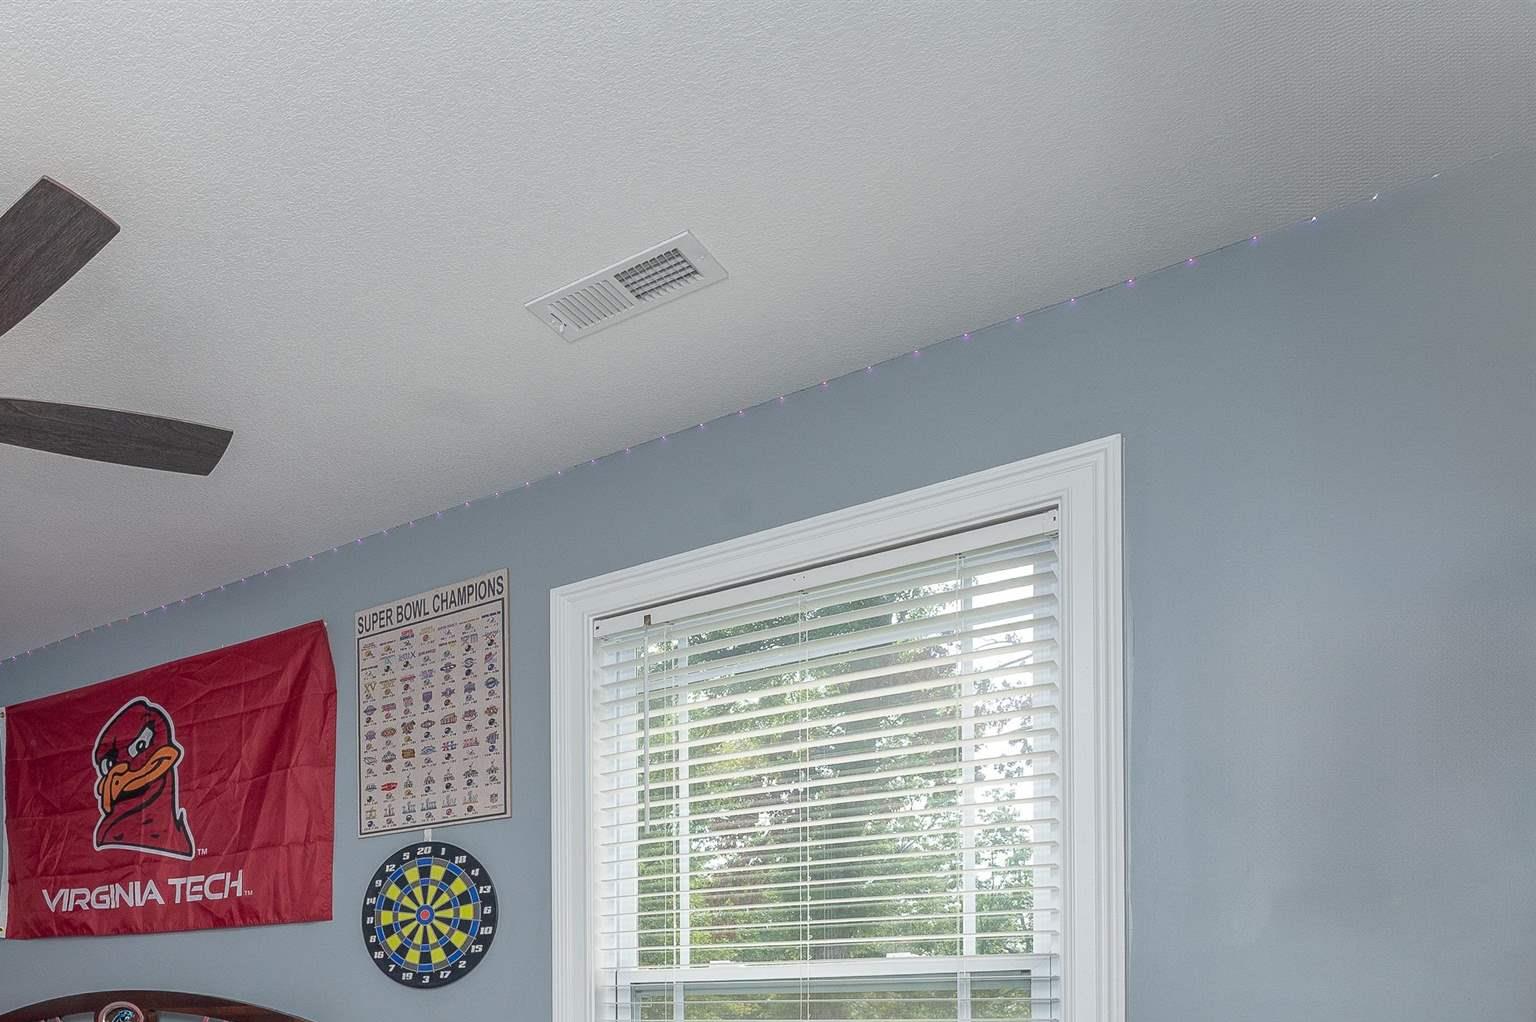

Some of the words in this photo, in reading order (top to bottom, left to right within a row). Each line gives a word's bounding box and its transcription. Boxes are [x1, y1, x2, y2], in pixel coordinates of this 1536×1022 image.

[357, 610, 395, 635] SUPER
[396, 598, 430, 623] BOWL
[431, 574, 505, 613] CHAMPIONS
[402, 851, 411, 860] 5
[416, 846, 432, 856] 20
[440, 847, 446, 856] 1
[454, 855, 467, 864] 18
[385, 864, 396, 872] 12
[470, 868, 481, 877] 4
[375, 879, 383, 888] 9
[42, 879, 165, 913] VIRGINIA
[167, 868, 243, 905] TECH
[478, 885, 492, 894] 13
[482, 906, 492, 915] 6
[479, 926, 493, 935] 10
[470, 944, 484, 954] 15
[373, 951, 385, 960] 16
[388, 964, 396, 973] 7
[457, 960, 467, 969] 2
[401, 972, 414, 981] 19
[439, 970, 452, 979] 17
[422, 975, 431, 984] 3
